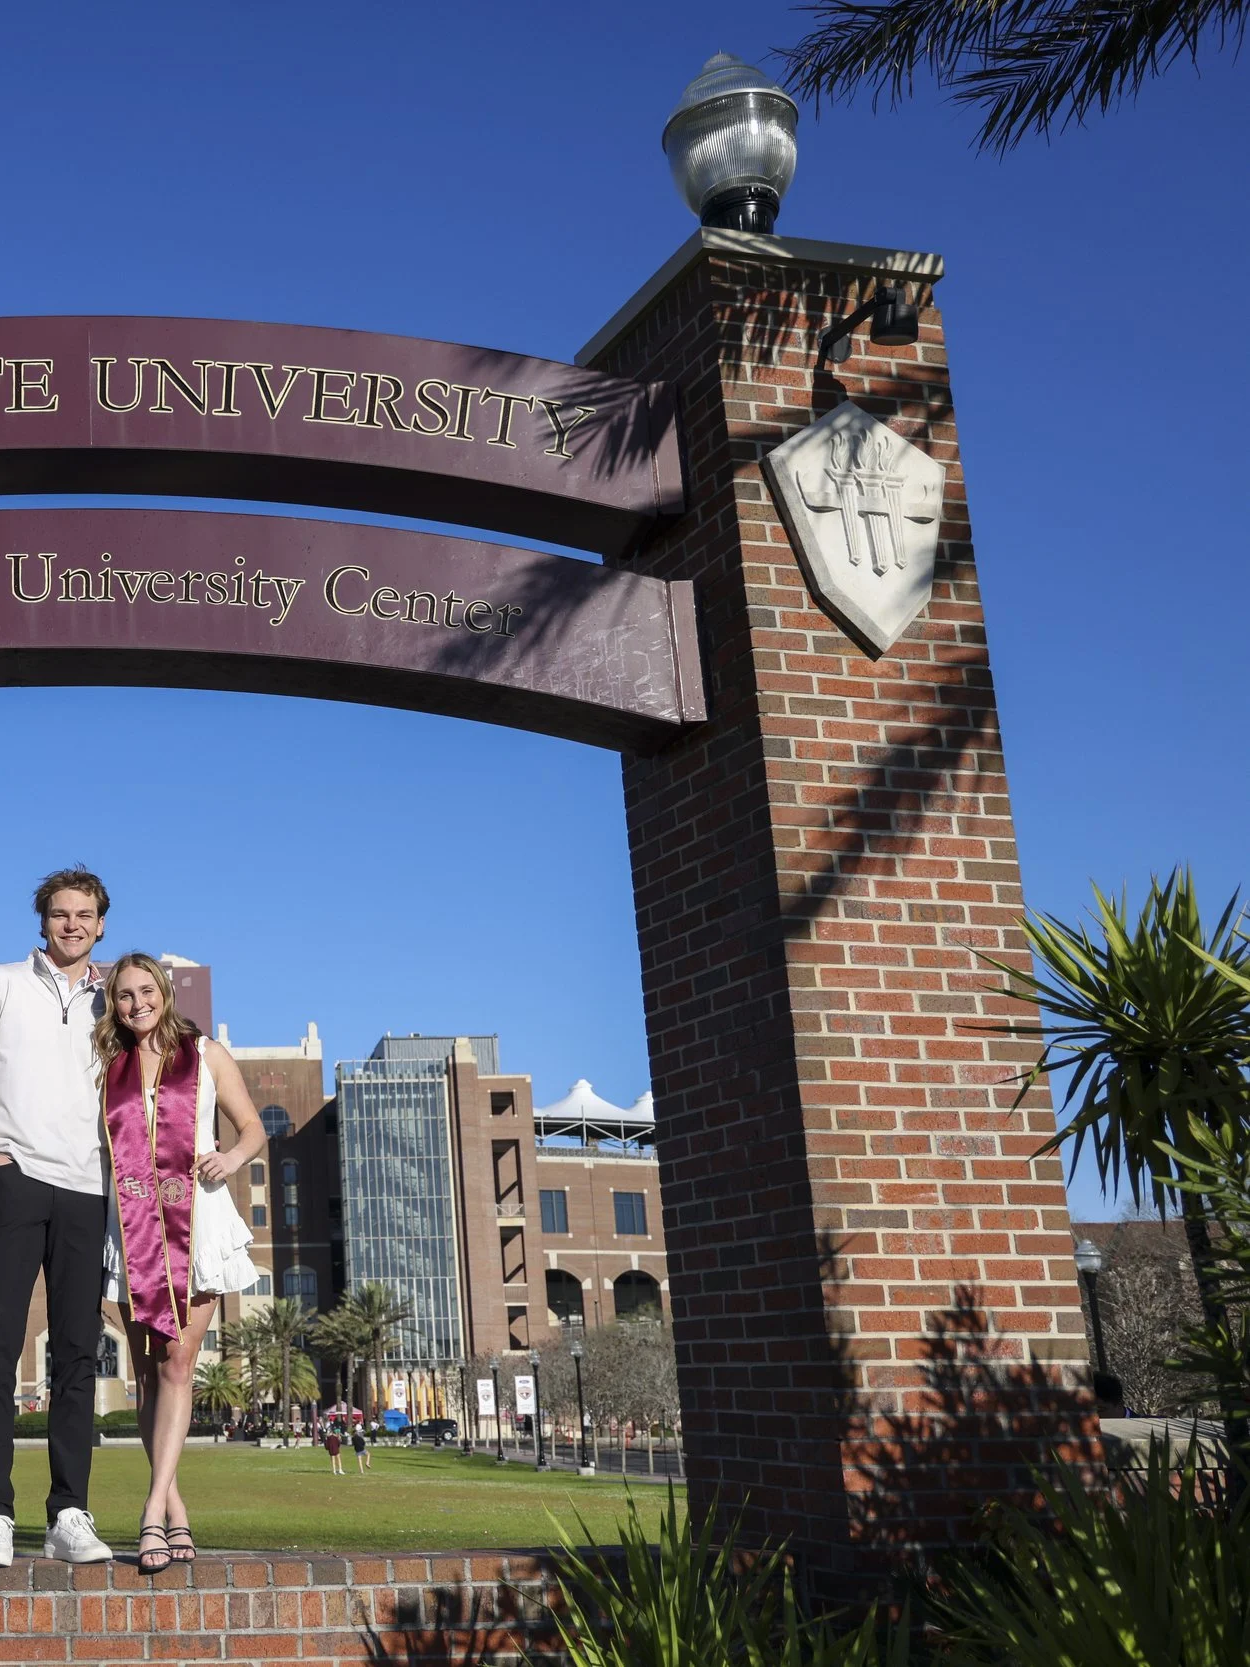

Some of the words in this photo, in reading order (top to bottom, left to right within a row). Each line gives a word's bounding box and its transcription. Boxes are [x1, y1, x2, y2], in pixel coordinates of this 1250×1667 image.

[90, 356, 597, 460] UNIVERSITY
[5, 552, 306, 627] University
[323, 564, 522, 639] Center
[123, 1176, 149, 1198] FSU
